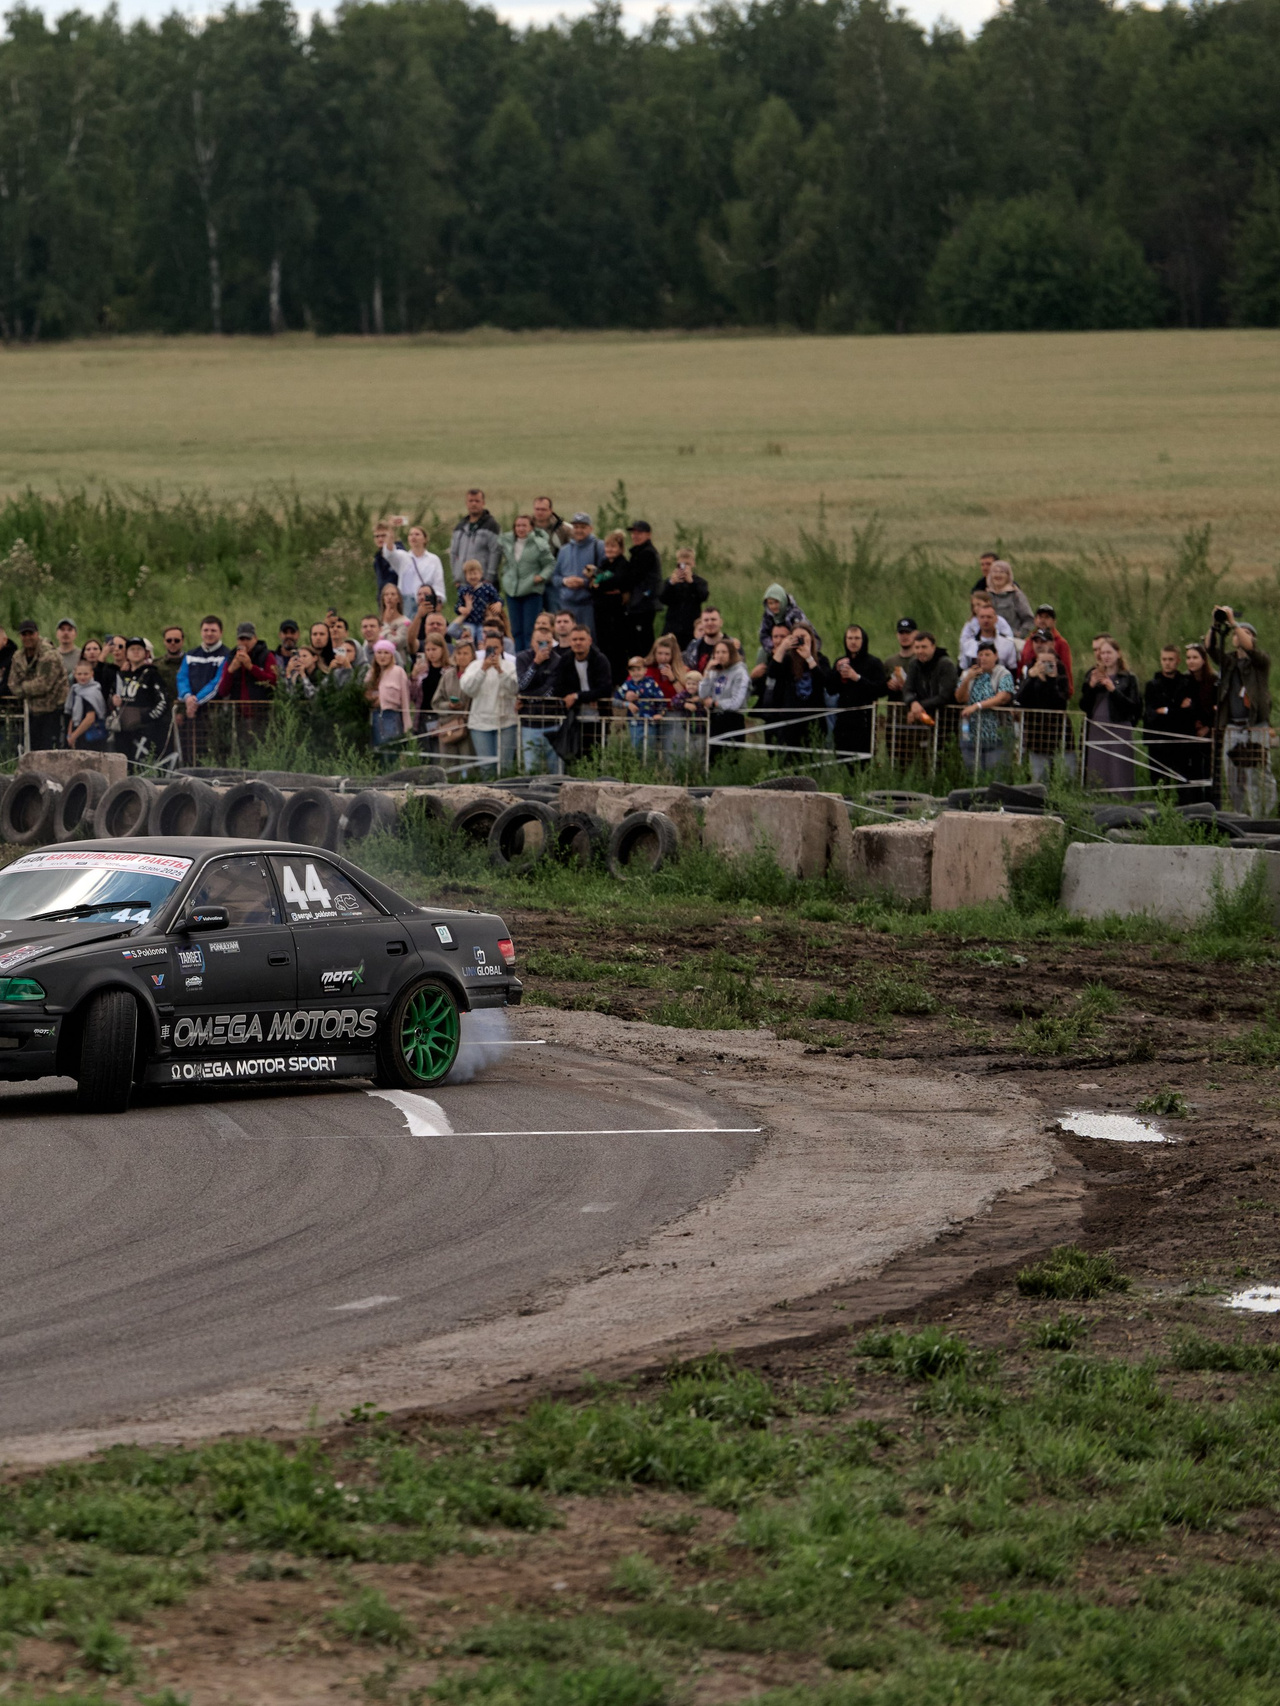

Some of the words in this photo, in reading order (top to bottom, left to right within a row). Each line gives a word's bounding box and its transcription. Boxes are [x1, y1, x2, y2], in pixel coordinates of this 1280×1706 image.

[46, 853, 139, 861] БАРНАУЛЬСКОЙ
[139, 856, 190, 869] РАКЕТЫ
[160, 868, 184, 876] 2025
[283, 864, 332, 910] 44
[110, 908, 151, 925] 44
[132, 947, 168, 959] S.Poklonov
[178, 950, 202, 965] TARGET
[174, 1013, 263, 1047] OMEGA
[267, 1008, 378, 1041] MOTORS
[236, 1058, 286, 1076] MOTOR
[288, 1056, 337, 1072] SPORT
